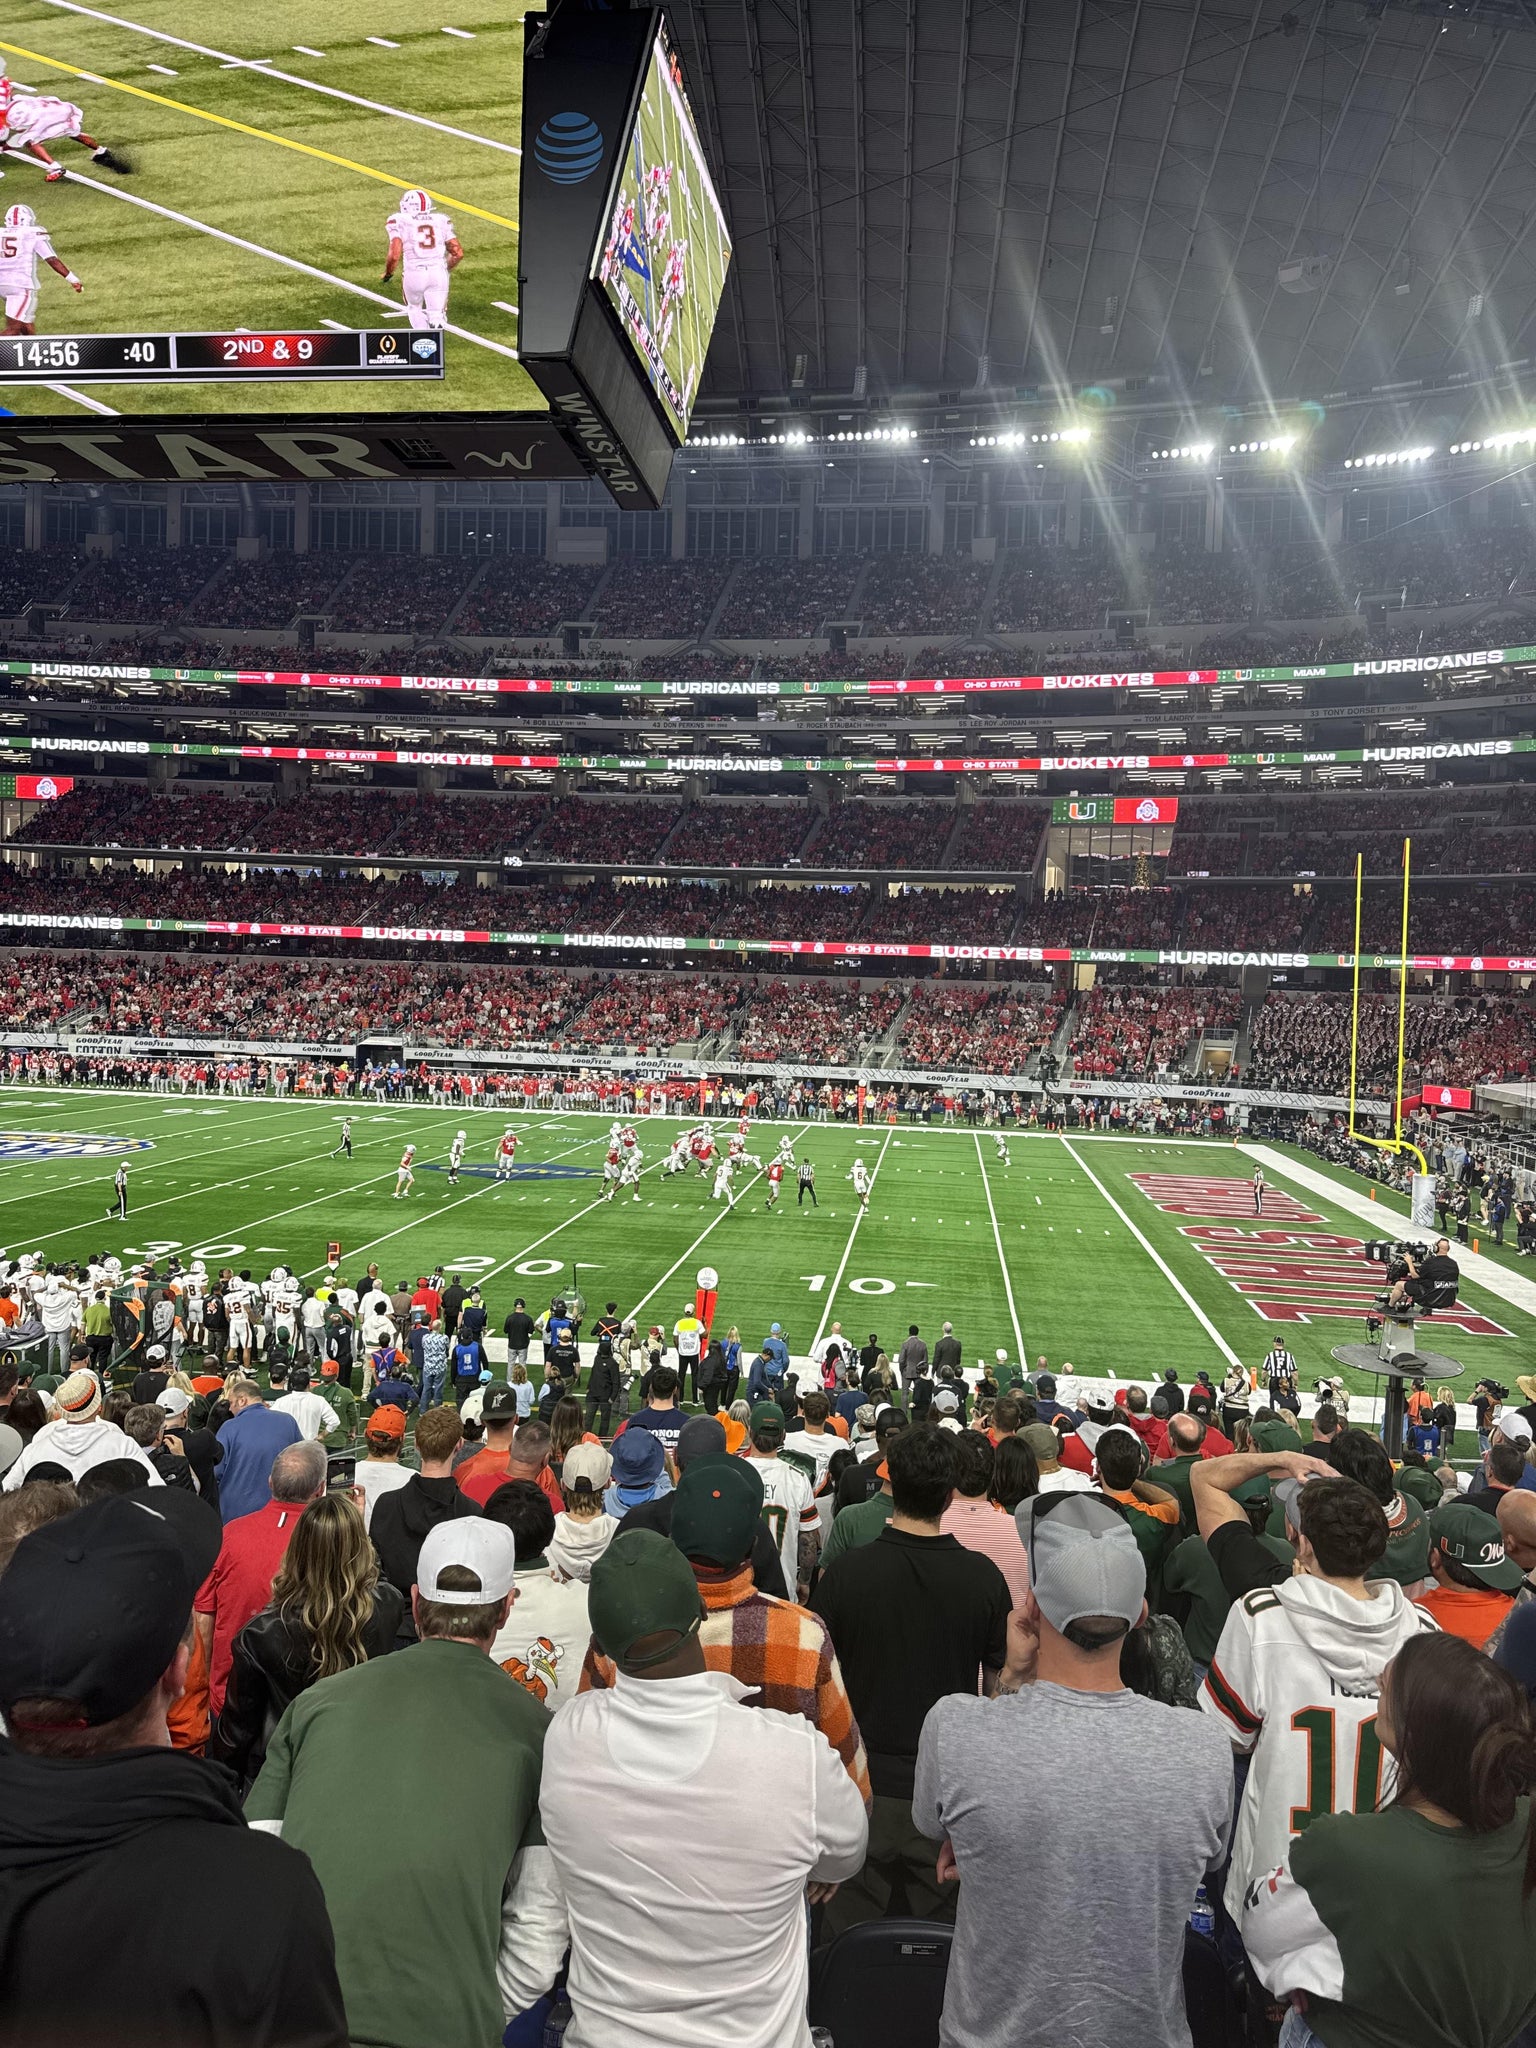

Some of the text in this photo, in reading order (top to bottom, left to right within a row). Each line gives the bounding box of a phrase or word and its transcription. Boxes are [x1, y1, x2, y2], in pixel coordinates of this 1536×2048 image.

[13, 341, 80, 367] 14:56
[123, 342, 155, 362] :40
[223, 339, 313, 360] 2ND & 9
[554, 392, 639, 493] WINSTAR
[31, 663, 151, 679] HURRICANES
[1293, 650, 1504, 677] MIAMI HURRICANES
[328, 676, 499, 691] OHIO STATE BUCKEYES
[614, 681, 780, 695] MIAMI HURRICANES
[964, 672, 1154, 689] OHIO STATE BUCKEYES
[1513, 695, 1534, 703] TEX
[400, 715, 431, 723] MEREDITH
[1163, 714, 1195, 722] LANDRY
[1322, 708, 1345, 717] TONY
[1347, 706, 1386, 715] DORSETT
[998, 719, 1027, 727] JORDAN
[31, 737, 150, 754] HURRICANES
[1303, 740, 1512, 762] MIAMI HURRICANES
[349, 752, 378, 760] STATE
[396, 751, 494, 766] BUCKEYES
[619, 758, 783, 772] MIAMI HURRICANES
[962, 755, 1150, 770] OHIO STATE BUCKEYES
[0, 913, 123, 930] HURRICANES
[280, 926, 466, 942] OHIO STATE BUCKEYES
[506, 933, 686, 949] MIAMI HURRICANES
[845, 945, 1043, 960] OHIO STATE BUCKEYES
[1090, 950, 1309, 967] MIAMI HURRICANES
[76, 1035, 124, 1045] GOODYEAR
[134, 1038, 174, 1048] GOODYEAR
[302, 1044, 342, 1053] GOODYEAR
[414, 1050, 454, 1058] GOODYEAR
[571, 1056, 612, 1066] GOODYEAR
[635, 1060, 683, 1068] GOODYEAR
[926, 1074, 970, 1083] GOODYEAR
[1182, 1088, 1231, 1098] GOODYEAR
[122, 1241, 248, 1259] 30
[328, 1242, 340, 1264] 2
[442, 1256, 566, 1276] 20
[188, 1284, 196, 1296] 8
[799, 1274, 897, 1295] 10
[227, 1301, 242, 1314] 12
[275, 1301, 291, 1314] 35
[1276, 1357, 1285, 1369] F
